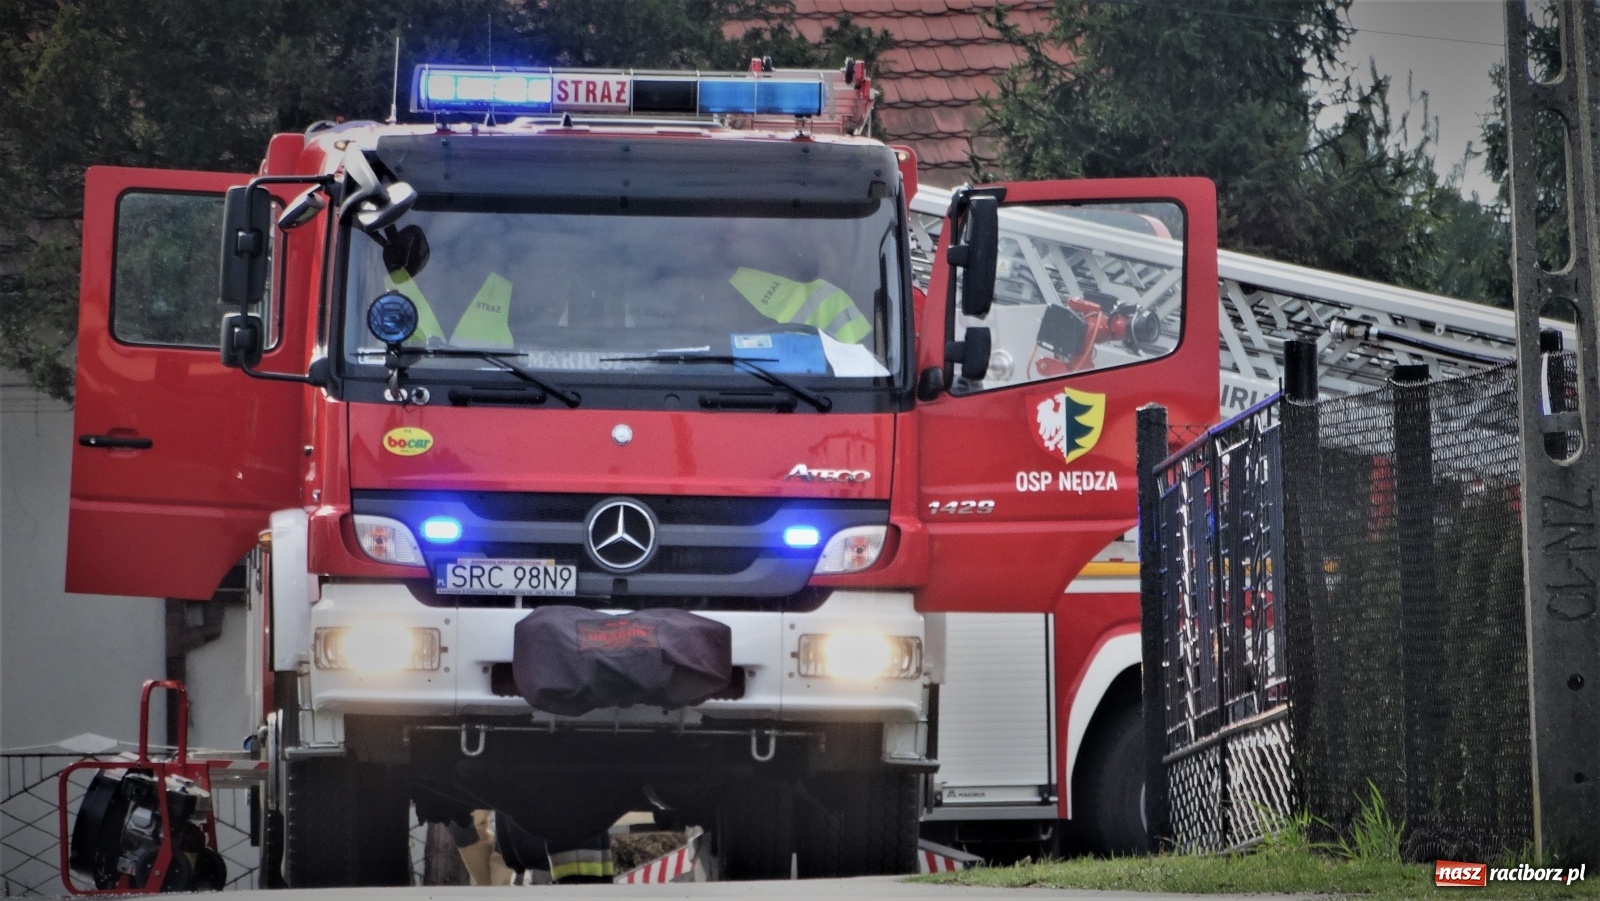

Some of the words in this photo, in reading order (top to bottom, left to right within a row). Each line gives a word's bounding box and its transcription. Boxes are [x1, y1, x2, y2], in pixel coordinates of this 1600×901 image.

[387, 436, 431, 449] bocar
[1015, 471, 1052, 492] OSP
[1058, 471, 1118, 495] NĘDZA
[928, 500, 995, 515] 1429
[451, 565, 504, 588] SRC
[513, 566, 572, 590] 98N9
